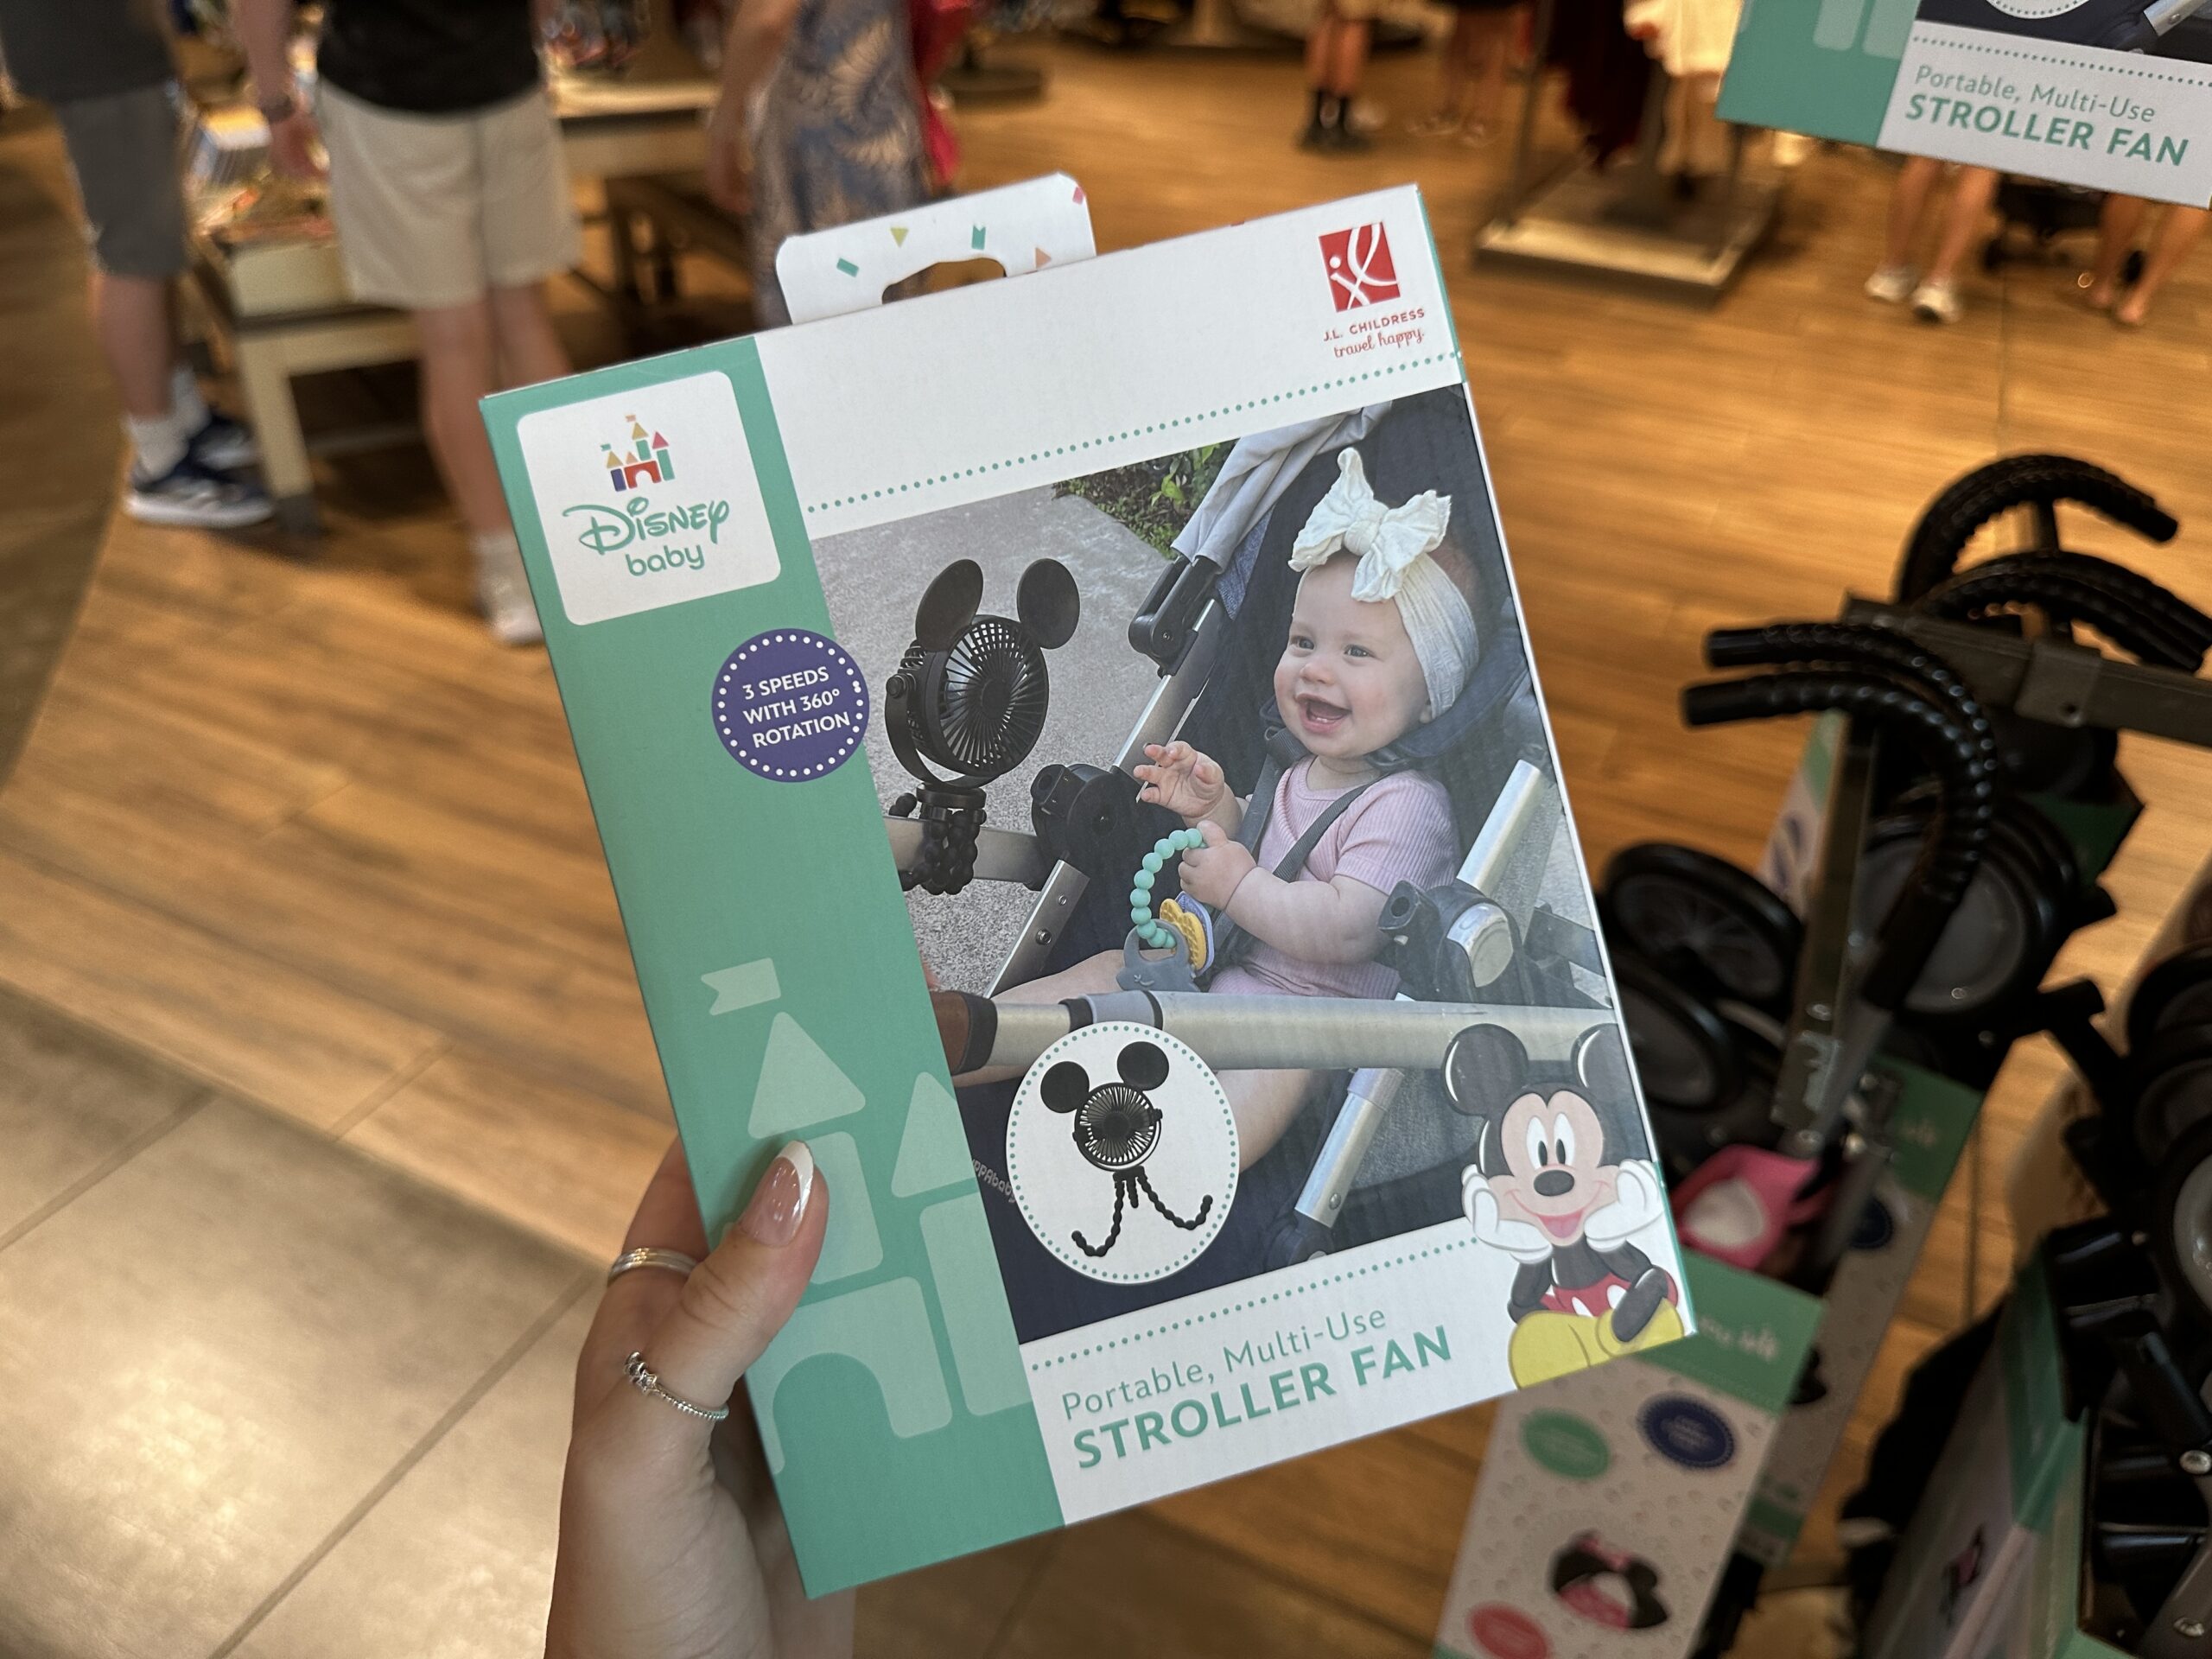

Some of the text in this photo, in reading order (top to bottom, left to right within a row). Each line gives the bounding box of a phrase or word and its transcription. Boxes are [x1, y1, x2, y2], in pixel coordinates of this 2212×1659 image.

[1914, 65, 2156, 123] Portable, Multi-Use
[1905, 94, 2190, 166] STROLLER FAN
[1324, 308, 1425, 342] J.L. CHILDRESS
[1333, 334, 1375, 359] travel
[625, 544, 705, 577] baby
[742, 666, 830, 700] 3 SPEEDS
[742, 699, 798, 725] WITH
[753, 711, 851, 748] ROTATION
[1060, 1309, 1386, 1421] Portable, Multi-Use
[1073, 1324, 1452, 1470] STROLLER FAN
